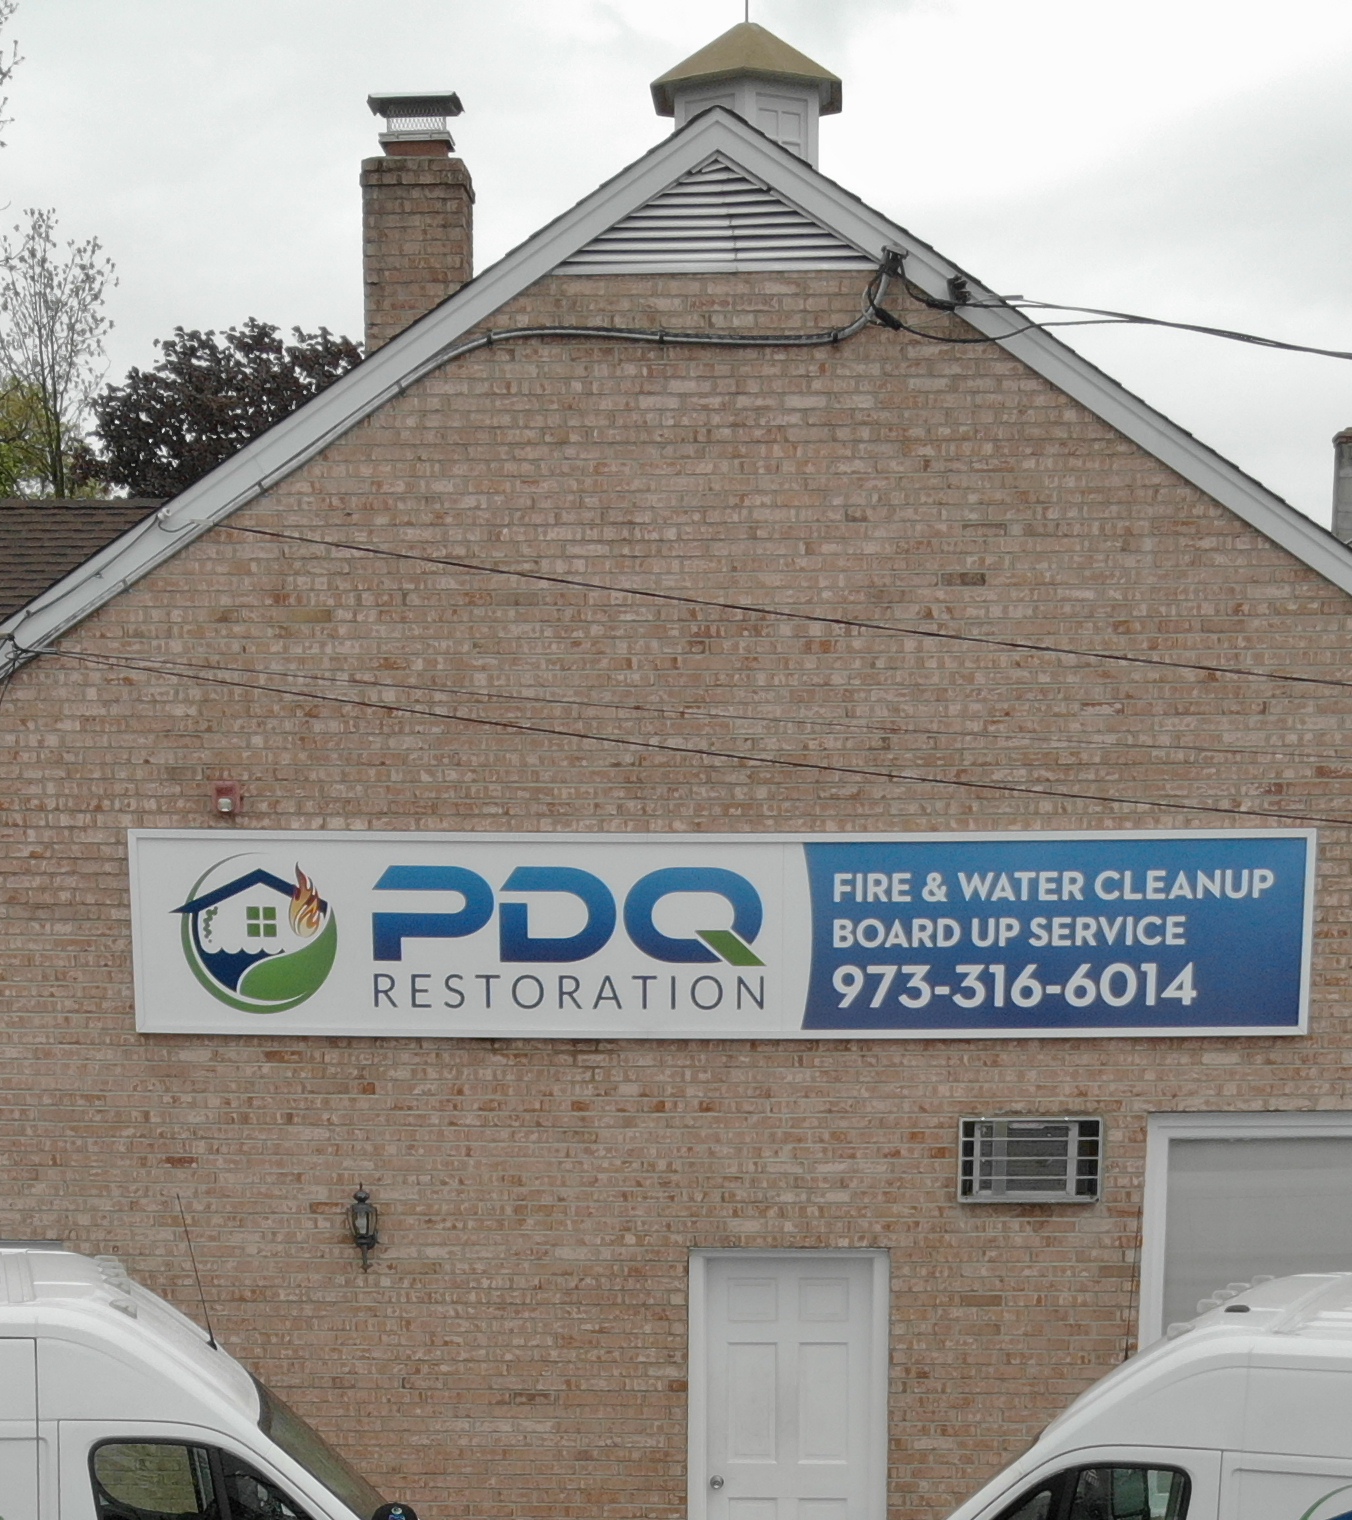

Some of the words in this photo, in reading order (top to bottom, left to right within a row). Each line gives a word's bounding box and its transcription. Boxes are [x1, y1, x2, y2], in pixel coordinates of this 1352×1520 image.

[833, 872, 912, 903] FIRE
[921, 873, 948, 902] &
[957, 871, 1084, 901] WATER
[1094, 869, 1275, 900] CLEANUP
[371, 864, 766, 967] PDQ
[833, 917, 962, 949] BOARD
[971, 916, 1021, 948] UP
[1029, 915, 1187, 946] SERVICE
[373, 973, 765, 1010] RESTORATION
[832, 962, 1198, 1009] 973-316-6014
